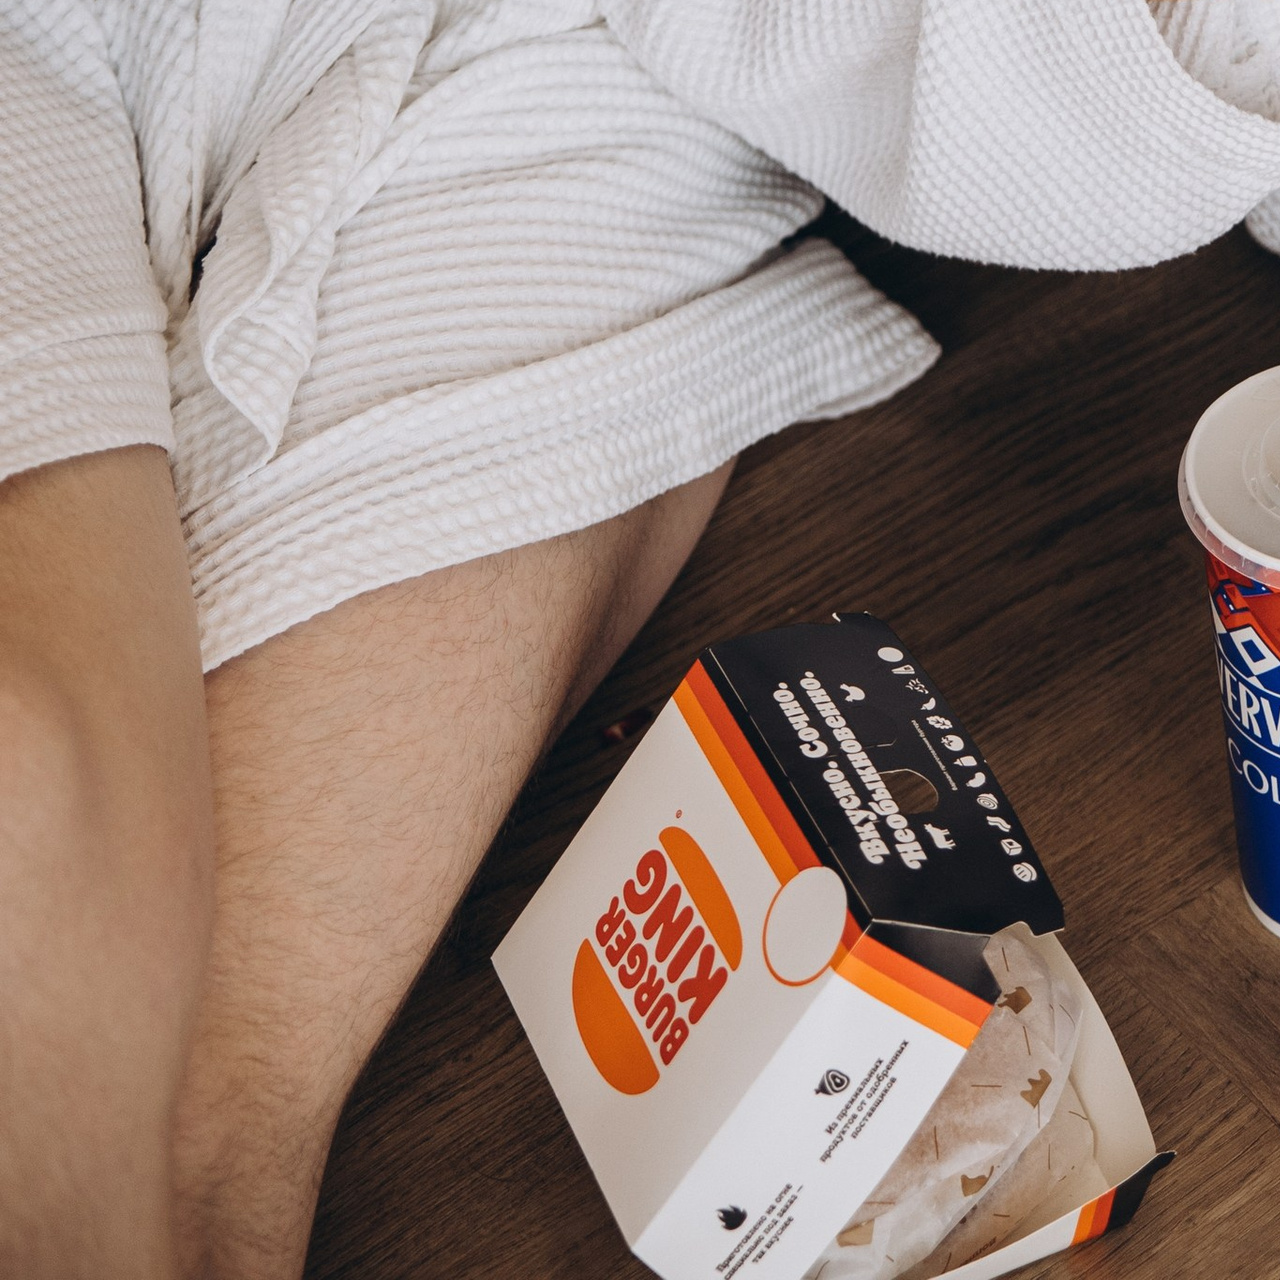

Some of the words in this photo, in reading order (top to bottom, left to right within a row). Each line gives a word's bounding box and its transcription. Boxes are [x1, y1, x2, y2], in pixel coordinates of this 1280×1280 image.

[773, 682, 829, 759] Сочно.
[800, 671, 928, 870] Необыкновенно.
[822, 760, 891, 865] Вкусно.
[595, 896, 690, 1066] BURGER
[622, 849, 728, 1025] KING
[819, 1113, 858, 1163] продуктов
[857, 1099, 867, 1113] от
[865, 1039, 909, 1099] одобренных
[825, 1121, 838, 1135] Из
[836, 1058, 884, 1121] премиальных
[851, 1076, 897, 1139] поставщиков
[715, 1214, 767, 1273] Приготовлено
[766, 1204, 776, 1215] на
[775, 1183, 793, 1203] огне
[724, 1235, 764, 1280] специально
[763, 1218, 778, 1234] под
[777, 1194, 798, 1218] заказ
[752, 1250, 766, 1263] так
[765, 1215, 794, 1249] вкуснее
